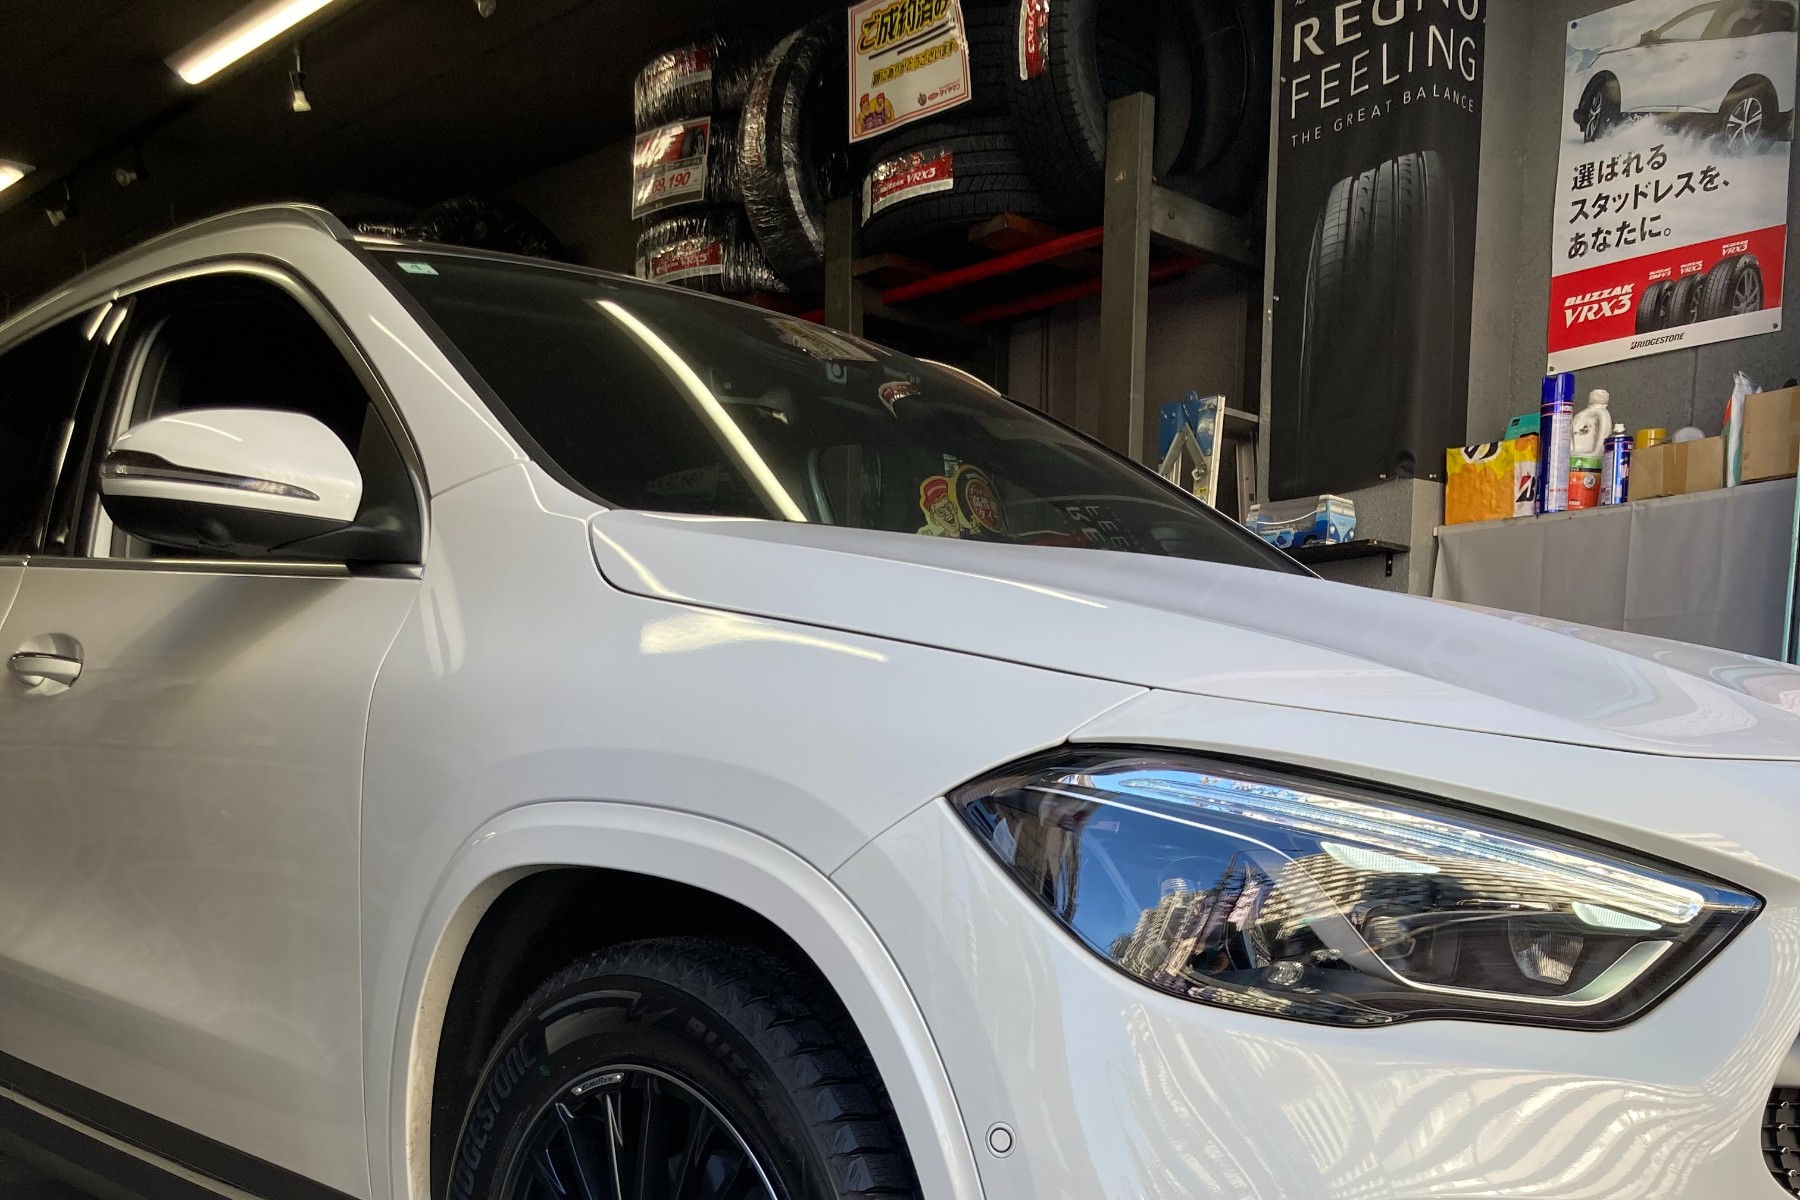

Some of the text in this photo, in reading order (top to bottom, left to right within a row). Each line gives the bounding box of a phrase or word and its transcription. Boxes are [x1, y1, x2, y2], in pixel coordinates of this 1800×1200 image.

[1293, 0, 1479, 63] REG
[1291, 25, 1476, 119] FEELING
[1291, 84, 1474, 147] THE GREAT BALANCE
[906, 167, 936, 185] VRX3
[1571, 143, 1668, 191] 選ばれる
[1569, 165, 1730, 225] スタッドレスを、
[1567, 214, 1672, 259] あなたに。
[1722, 244, 1749, 257] VRX3
[1564, 283, 1636, 307] BLIZZAK
[1564, 294, 1633, 329] VRX3
[1630, 332, 1686, 350] BRIDGESTONE
